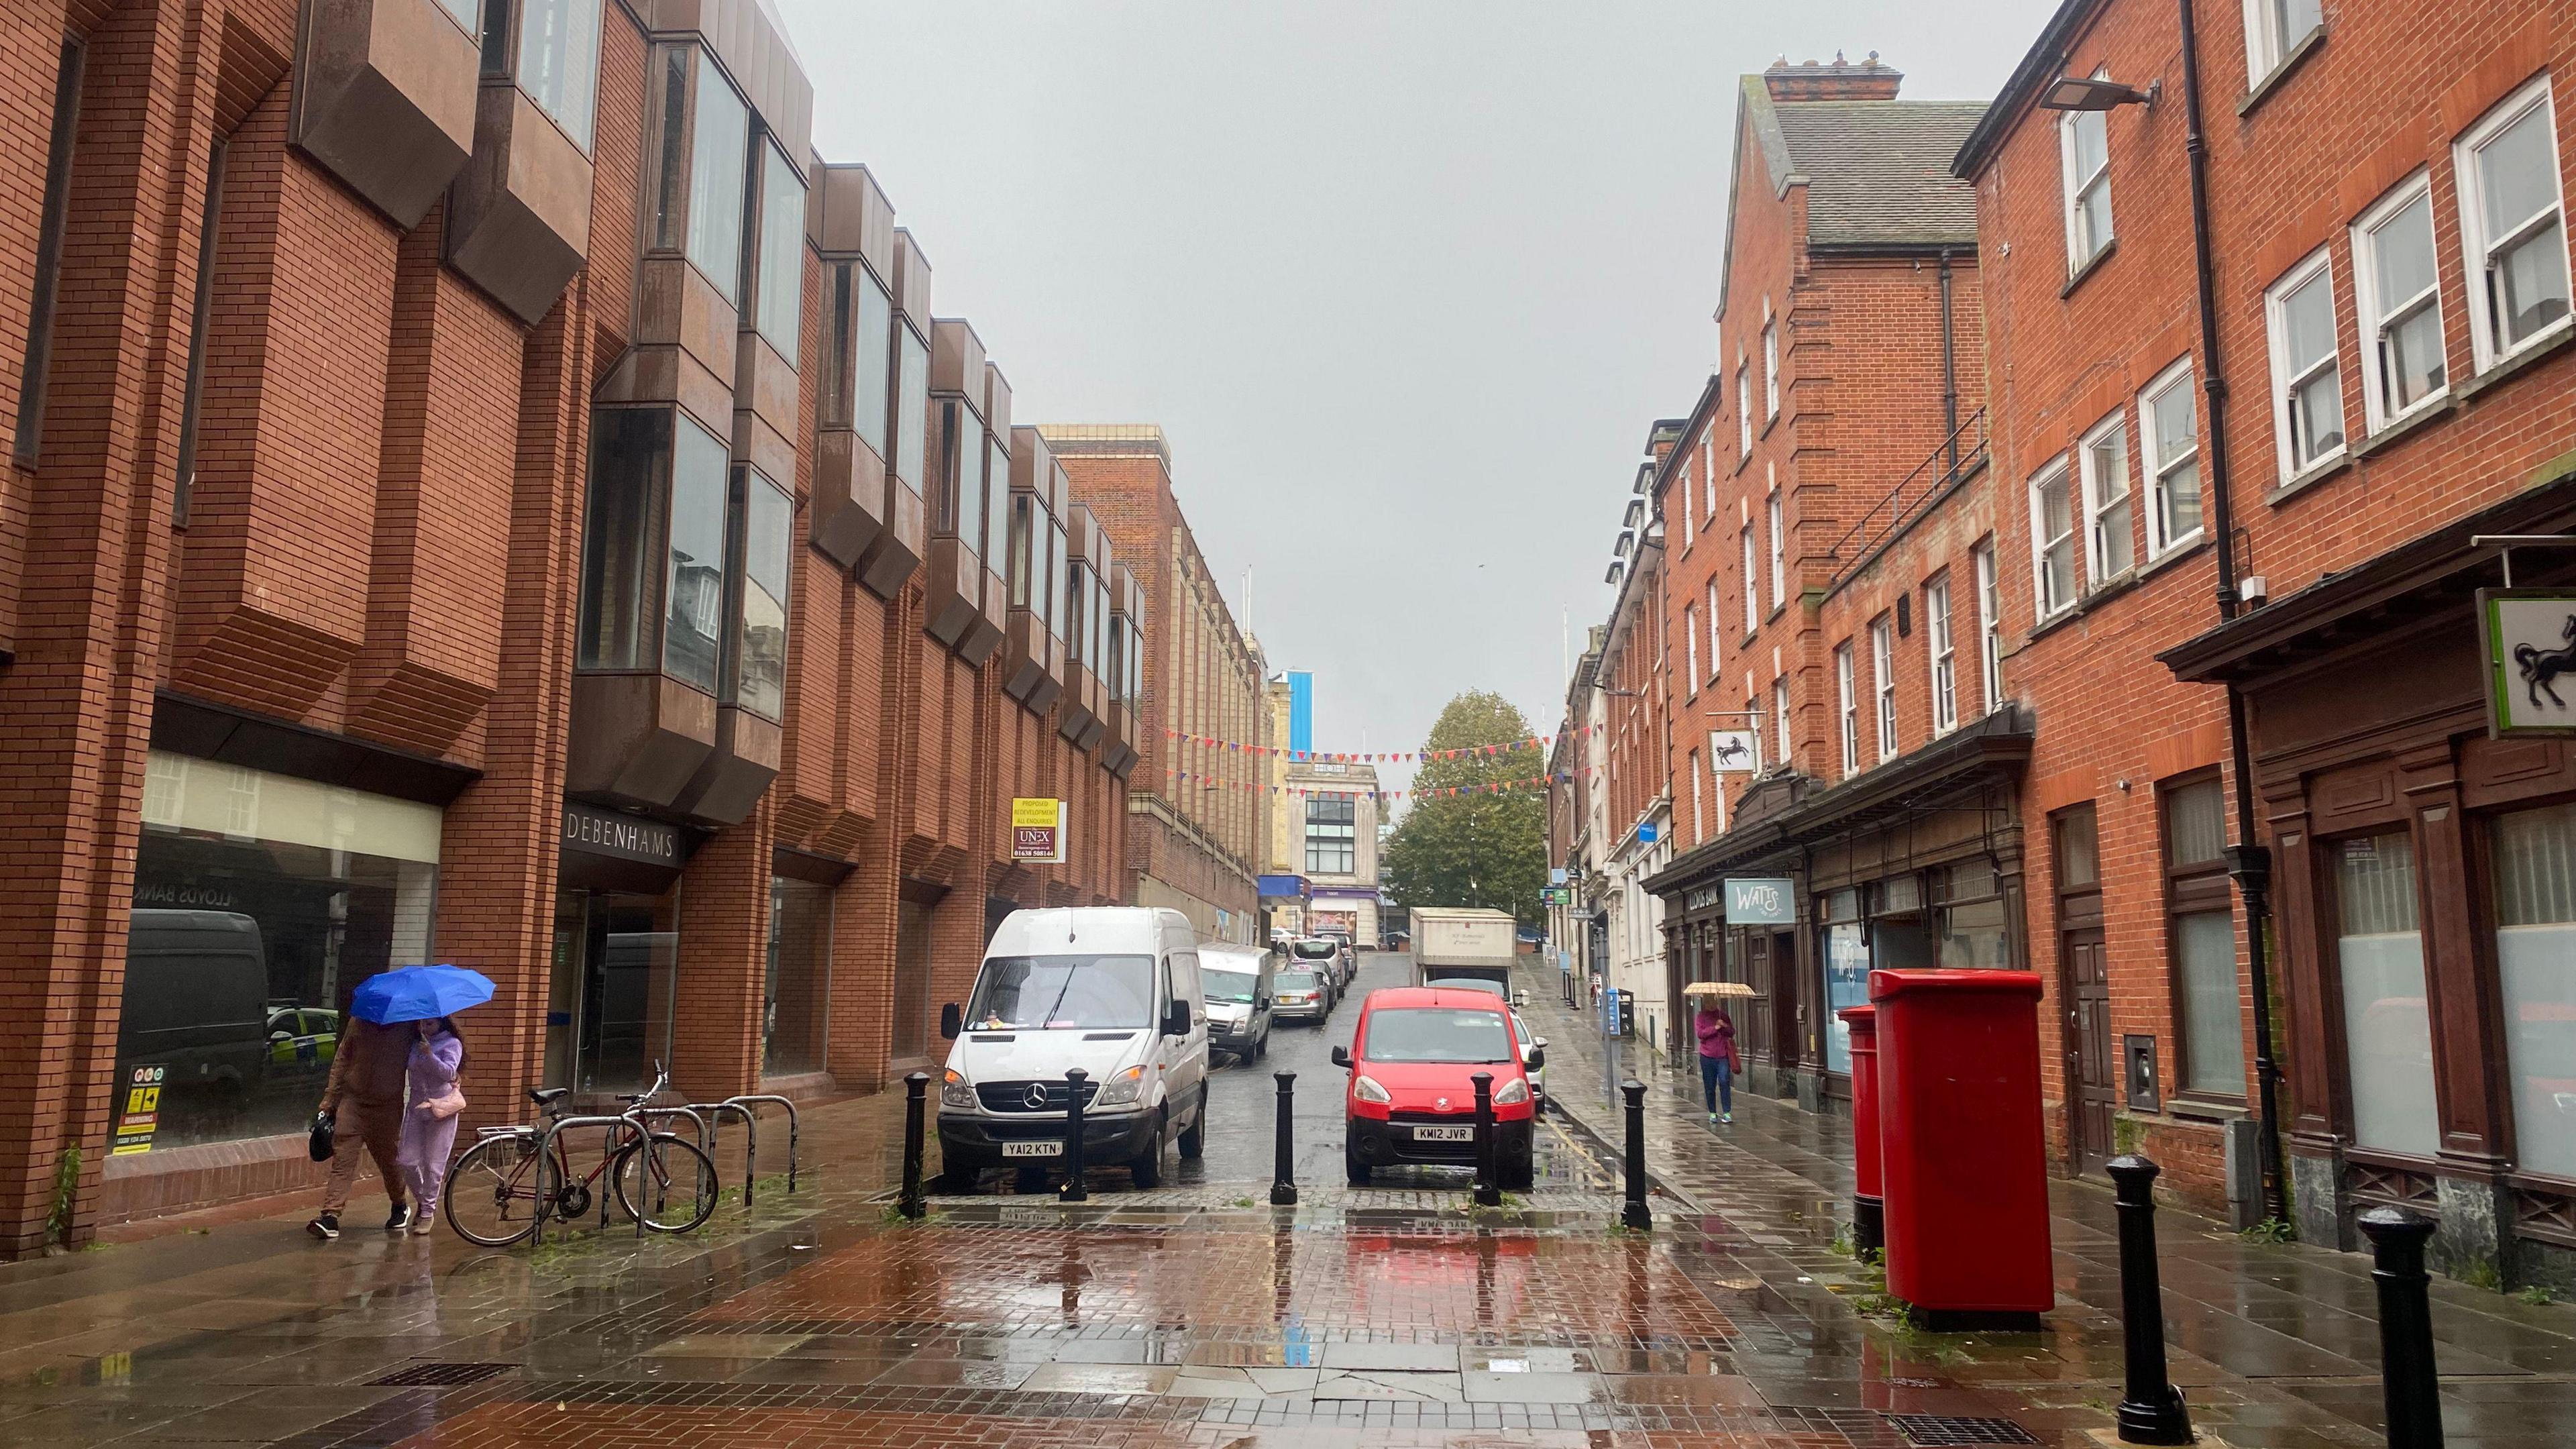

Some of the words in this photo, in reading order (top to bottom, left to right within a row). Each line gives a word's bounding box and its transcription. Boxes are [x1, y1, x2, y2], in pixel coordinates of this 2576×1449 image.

[568, 813, 672, 857] DEBENHAMS
[1020, 831, 1049, 842] UNEX
[1420, 1128, 1443, 1138] KM12
[1446, 1129, 1466, 1139] JVR
[1009, 1144, 1032, 1154] YA12
[1035, 1144, 1056, 1154] KTN
